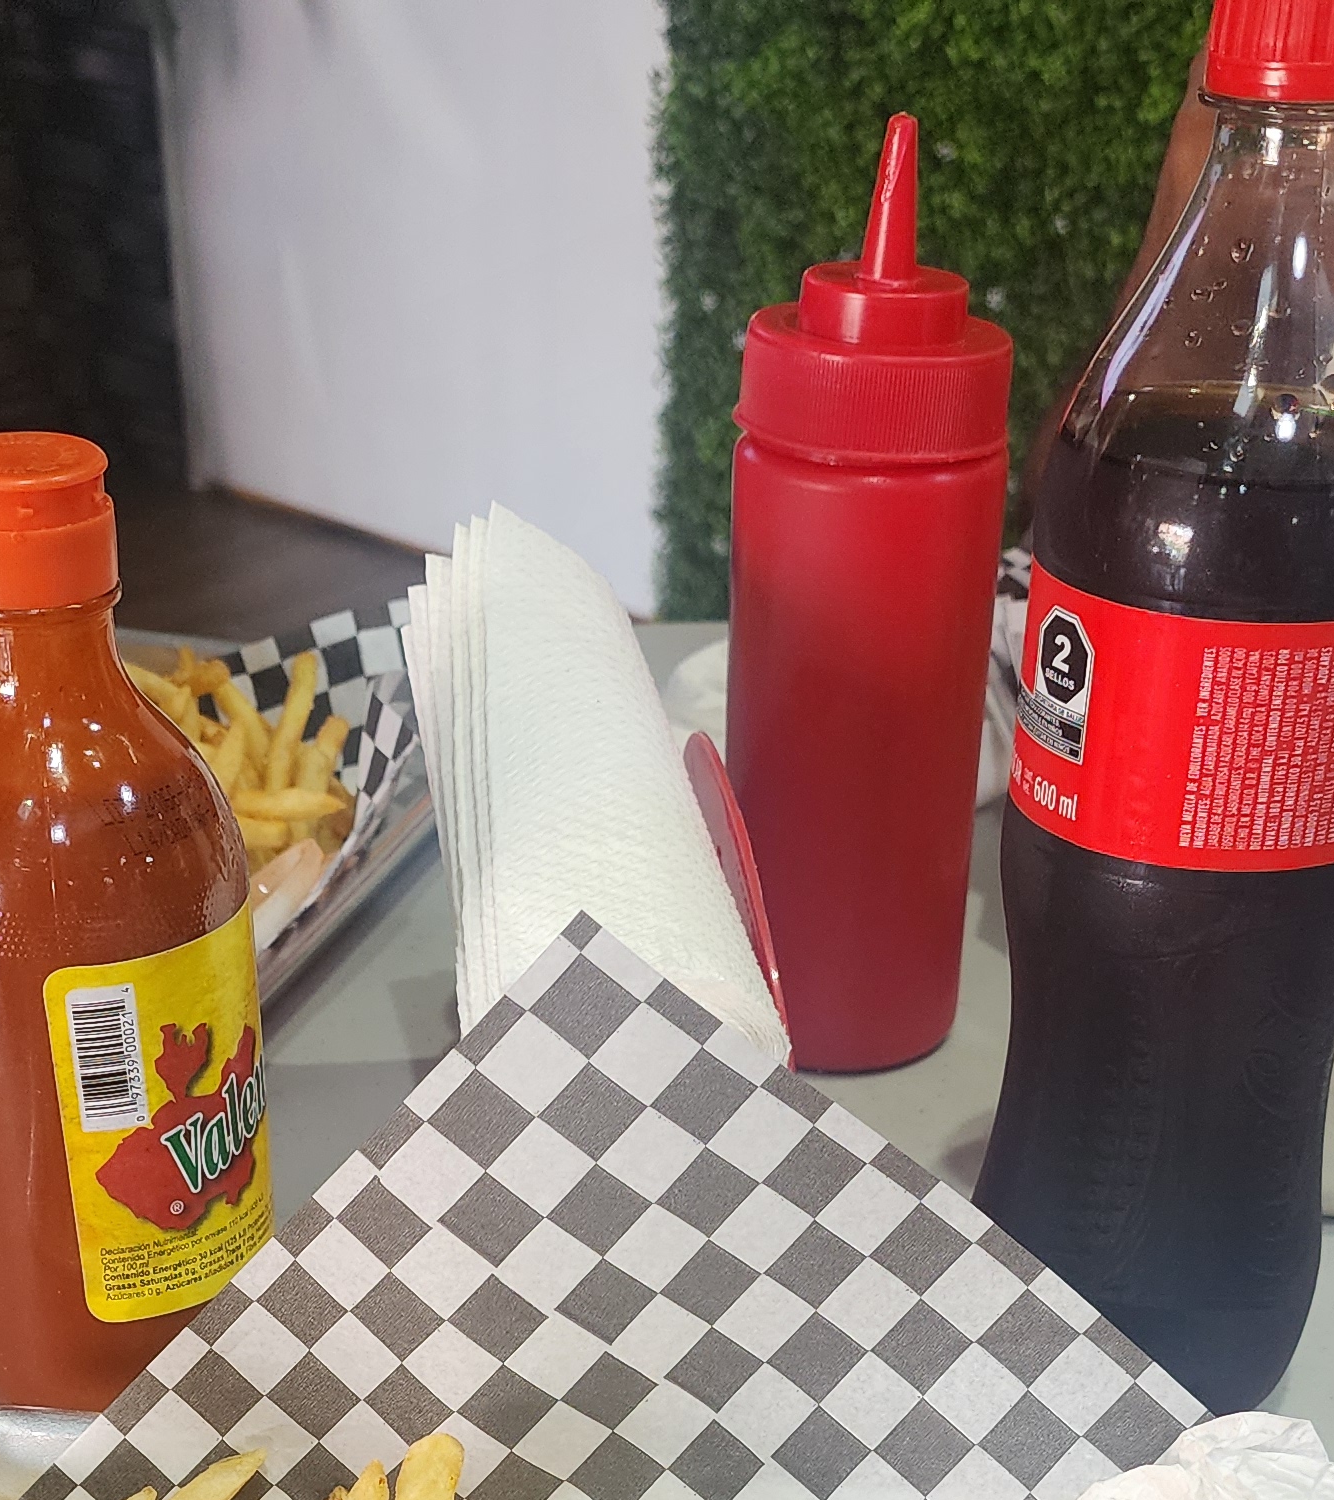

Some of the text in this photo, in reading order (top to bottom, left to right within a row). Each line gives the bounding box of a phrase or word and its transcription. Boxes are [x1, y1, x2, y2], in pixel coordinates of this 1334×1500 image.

[1051, 634, 1072, 674] 2
[1045, 668, 1075, 691] SELLOS
[1033, 776, 1057, 811] 600
[1058, 793, 1078, 821] ml
[122, 986, 145, 1124] 0 97339 00021 4
[103, 1269, 151, 1282] Contenido
[152, 1256, 197, 1275] Energético
[209, 1243, 223, 1256] kcal
[104, 1283, 137, 1291] Grasas
[139, 1272, 182, 1287] Saturadas
[199, 1255, 224, 1270] Grasas
[122, 1262, 138, 1271] 100
[105, 1291, 146, 1301] Azúcares
[164, 1275, 202, 1292] Azúcares
